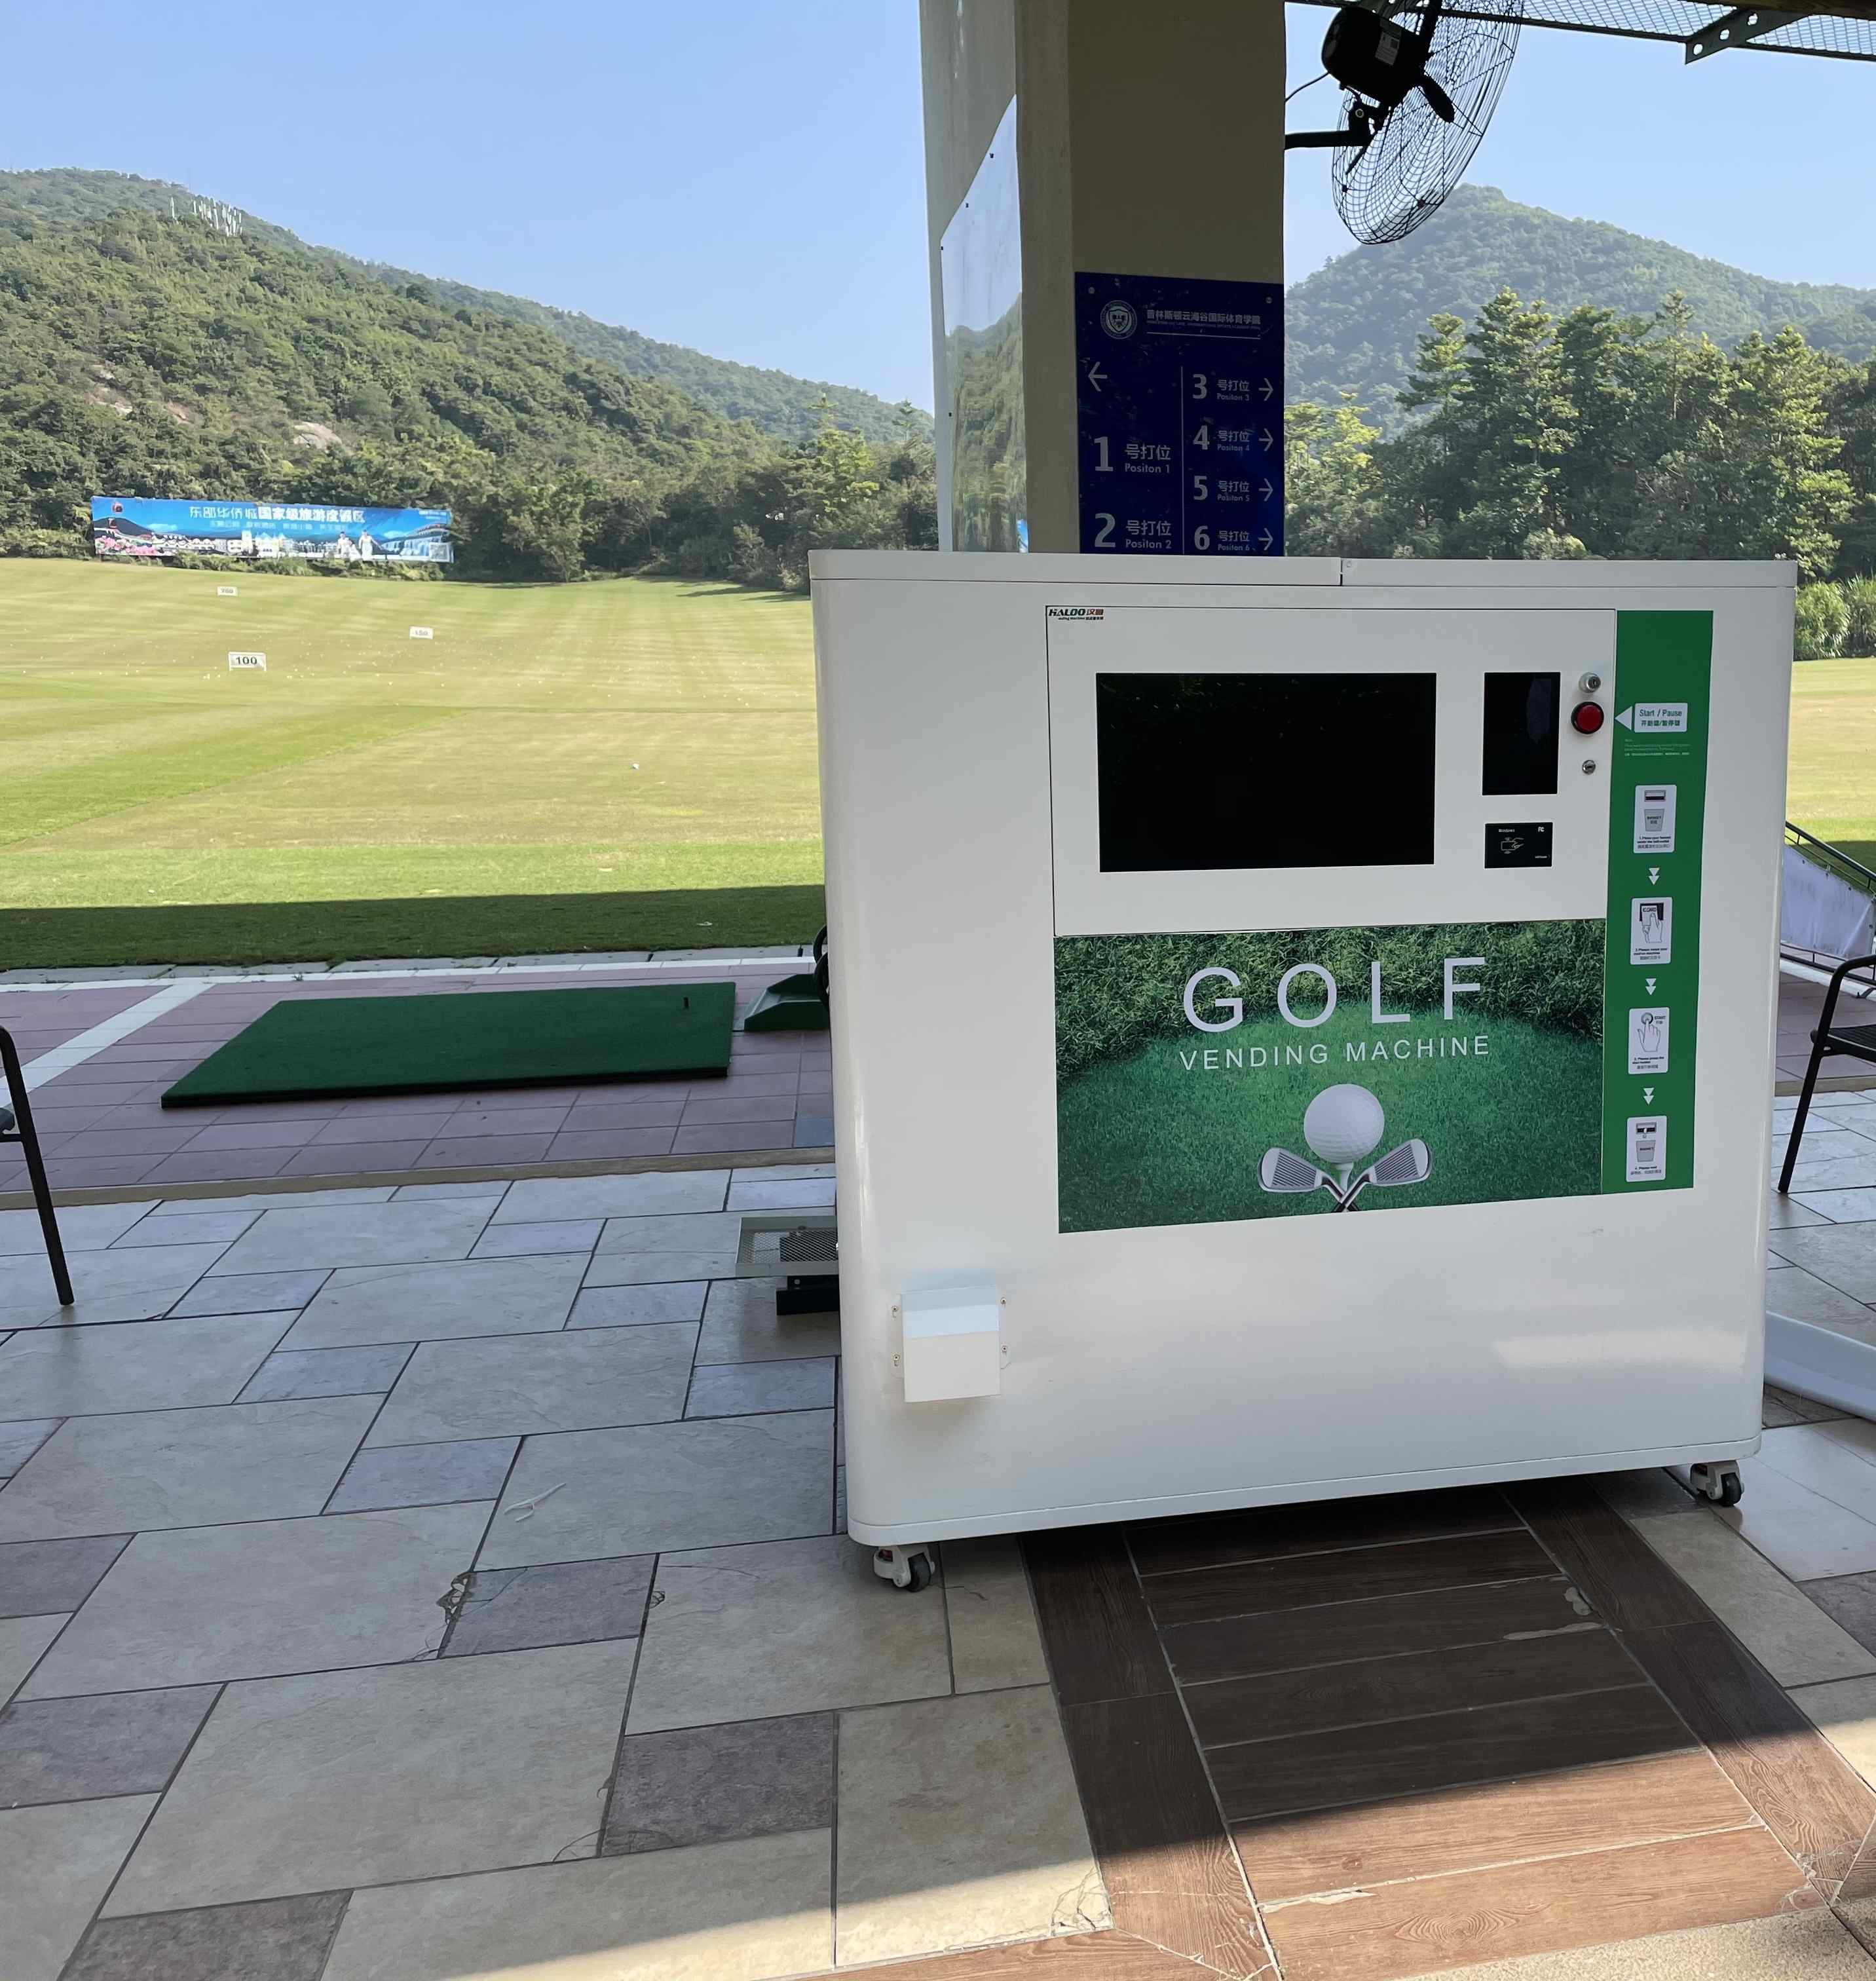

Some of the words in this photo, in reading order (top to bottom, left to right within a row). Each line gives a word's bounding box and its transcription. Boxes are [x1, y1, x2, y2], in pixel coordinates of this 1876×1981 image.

[1192, 373, 1208, 400] 3
[1216, 379, 1250, 392] 号打位
[1193, 425, 1210, 451] 4
[1217, 430, 1250, 442] 号打位
[1093, 436, 1114, 472] 1
[1124, 442, 1171, 461] 号打位
[1165, 464, 1170, 474] 1
[1193, 475, 1209, 500] 5
[1217, 480, 1250, 493] 号打位
[1094, 512, 1116, 548] 2
[1125, 519, 1172, 537] 号打位
[1194, 525, 1210, 551] 6
[1218, 530, 1250, 542] 号打位
[1165, 539, 1172, 549] 2
[236, 656, 257, 665] 100
[1662, 709, 1682, 717] Pause
[1182, 957, 1486, 1033] GOLF
[1180, 1043, 1329, 1071] VENDING
[1345, 1034, 1490, 1063] MACHINE
